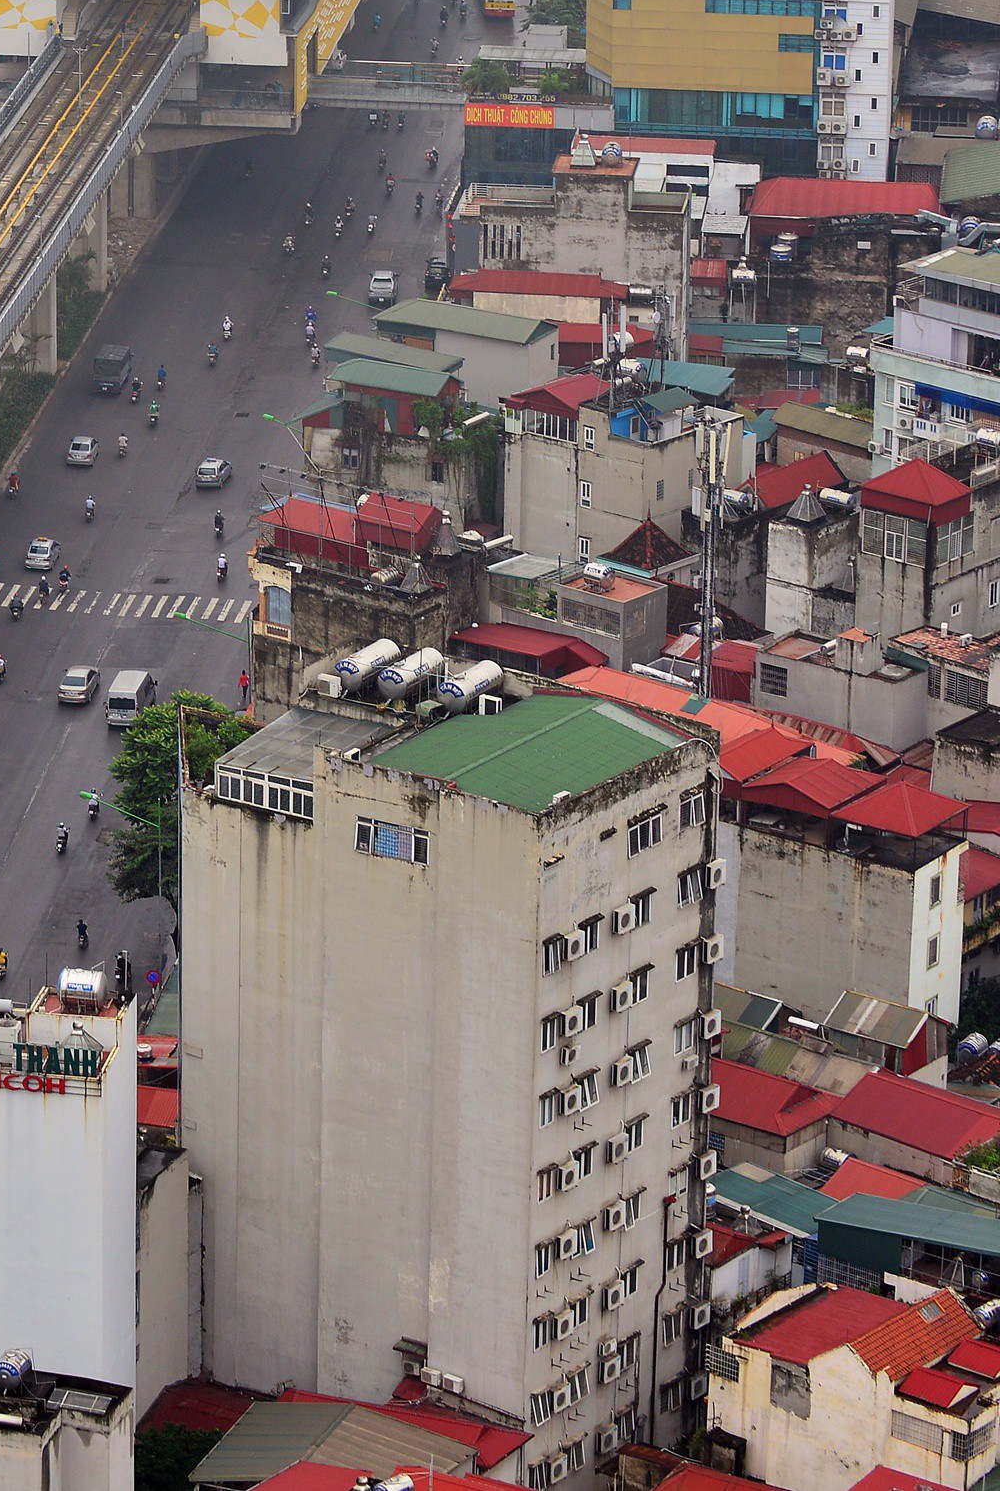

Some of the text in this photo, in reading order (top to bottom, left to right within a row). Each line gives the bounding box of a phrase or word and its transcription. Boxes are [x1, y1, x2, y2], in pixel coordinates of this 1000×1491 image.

[466, 107, 482, 125] DỊCH
[484, 106, 505, 126] THUẬT
[510, 106, 529, 124] CÔNG
[13, 1043, 97, 1077] THANH
